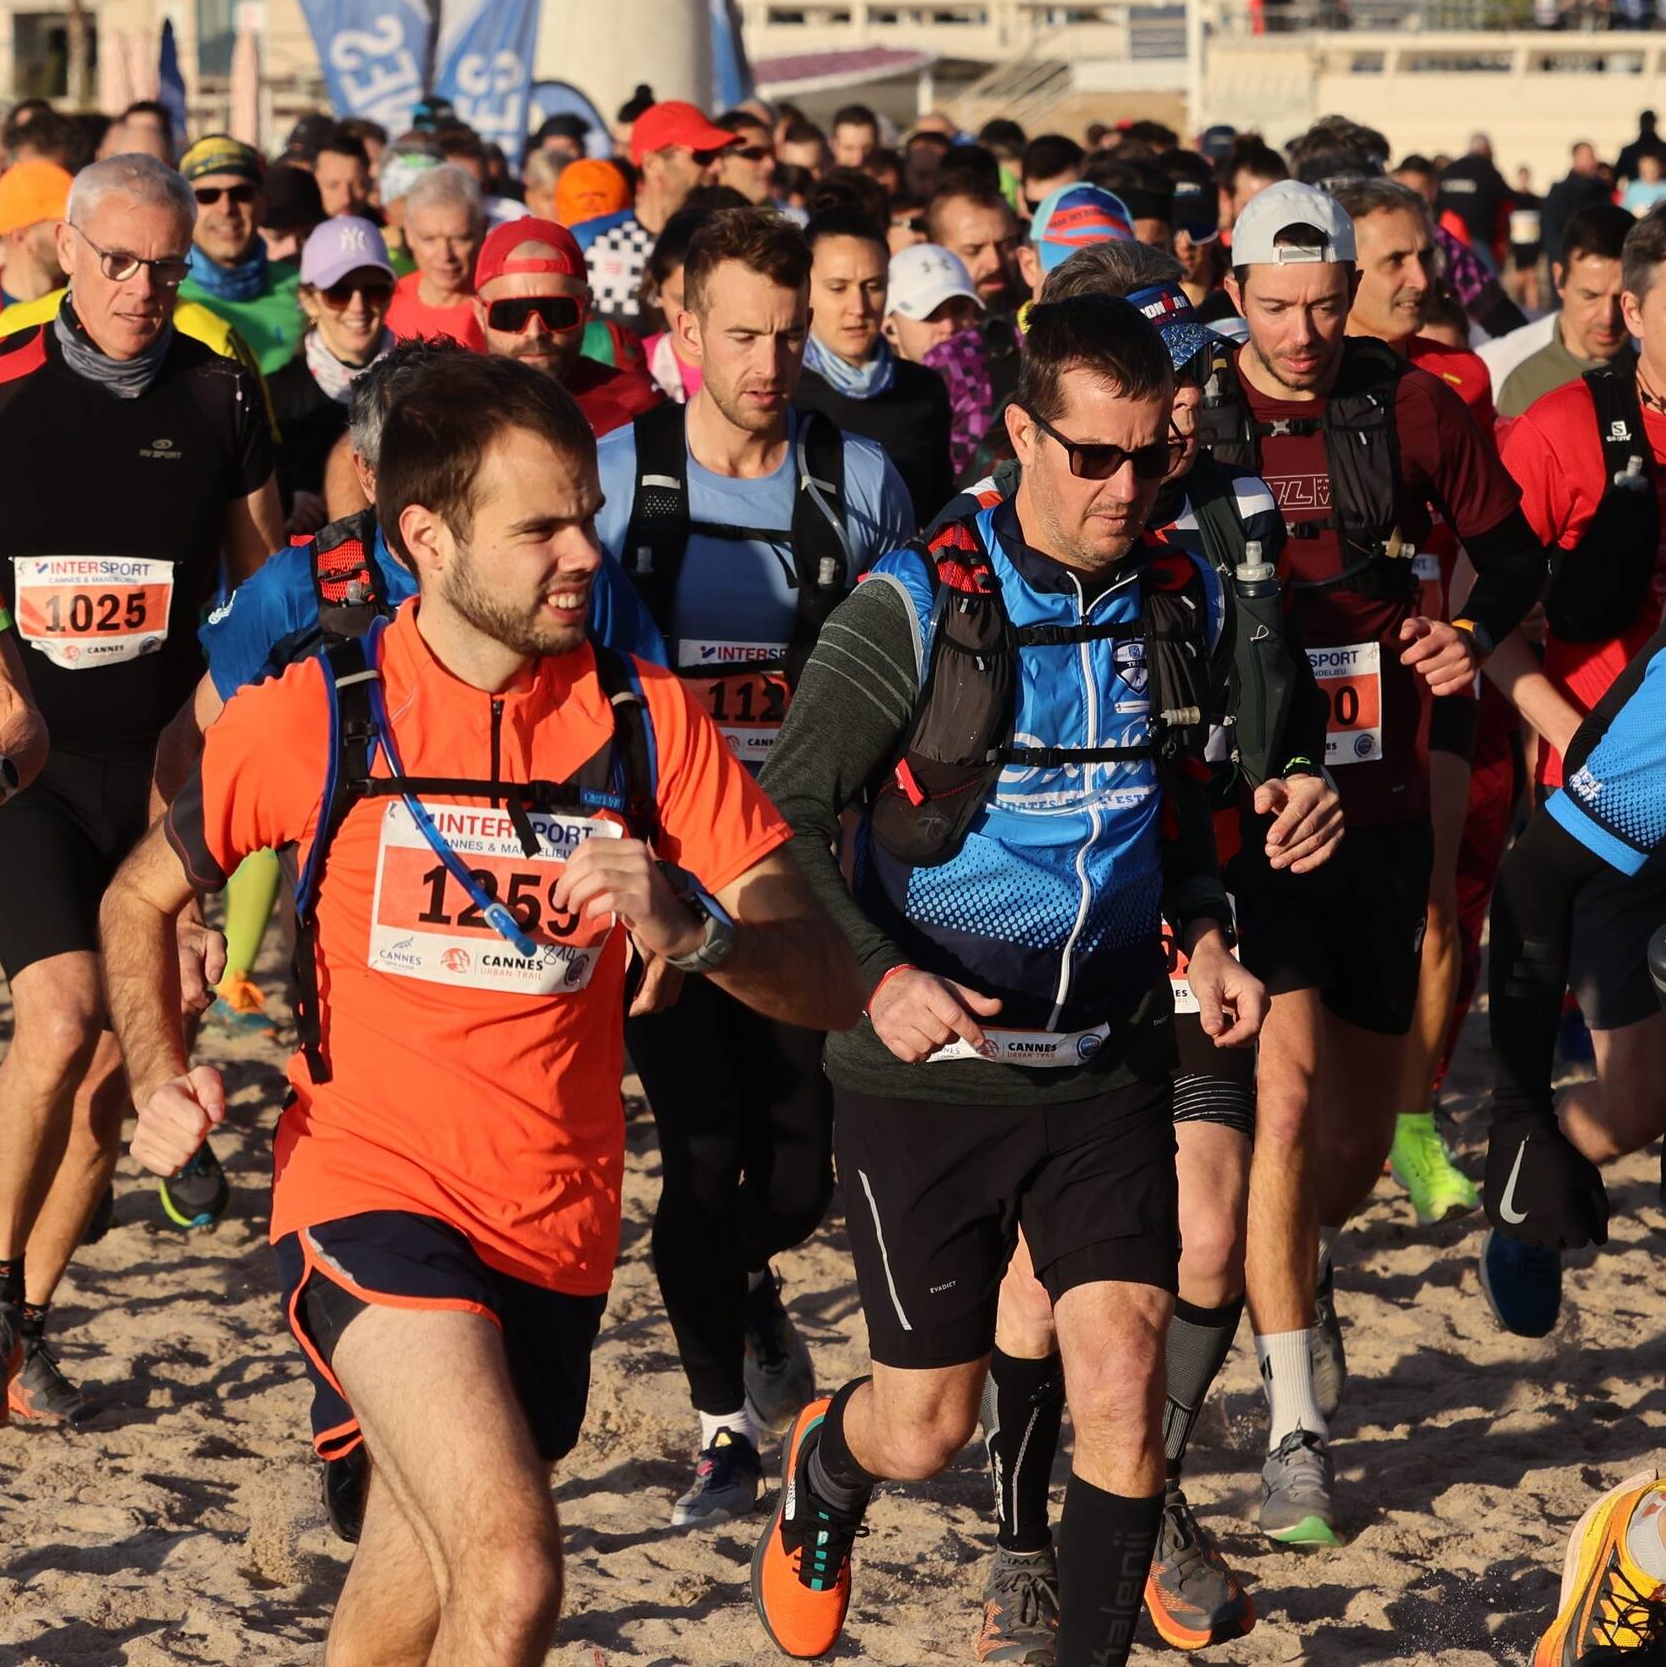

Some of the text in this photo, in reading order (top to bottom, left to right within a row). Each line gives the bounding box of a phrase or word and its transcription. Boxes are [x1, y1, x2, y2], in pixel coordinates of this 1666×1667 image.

[50, 561, 151, 576] INTERSPORT
[45, 592, 146, 633] 1025
[439, 813, 594, 846] INTERPORT
[441, 838, 483, 851] ANNES
[489, 844, 496, 852] &
[418, 865, 582, 937] 1259
[380, 949, 422, 966] CANNES
[482, 954, 544, 971] CANNES
[480, 968, 543, 981] URBAN TRAIL
[1008, 1042, 1057, 1052] CANNES
[930, 1279, 957, 1293] EVADICT
